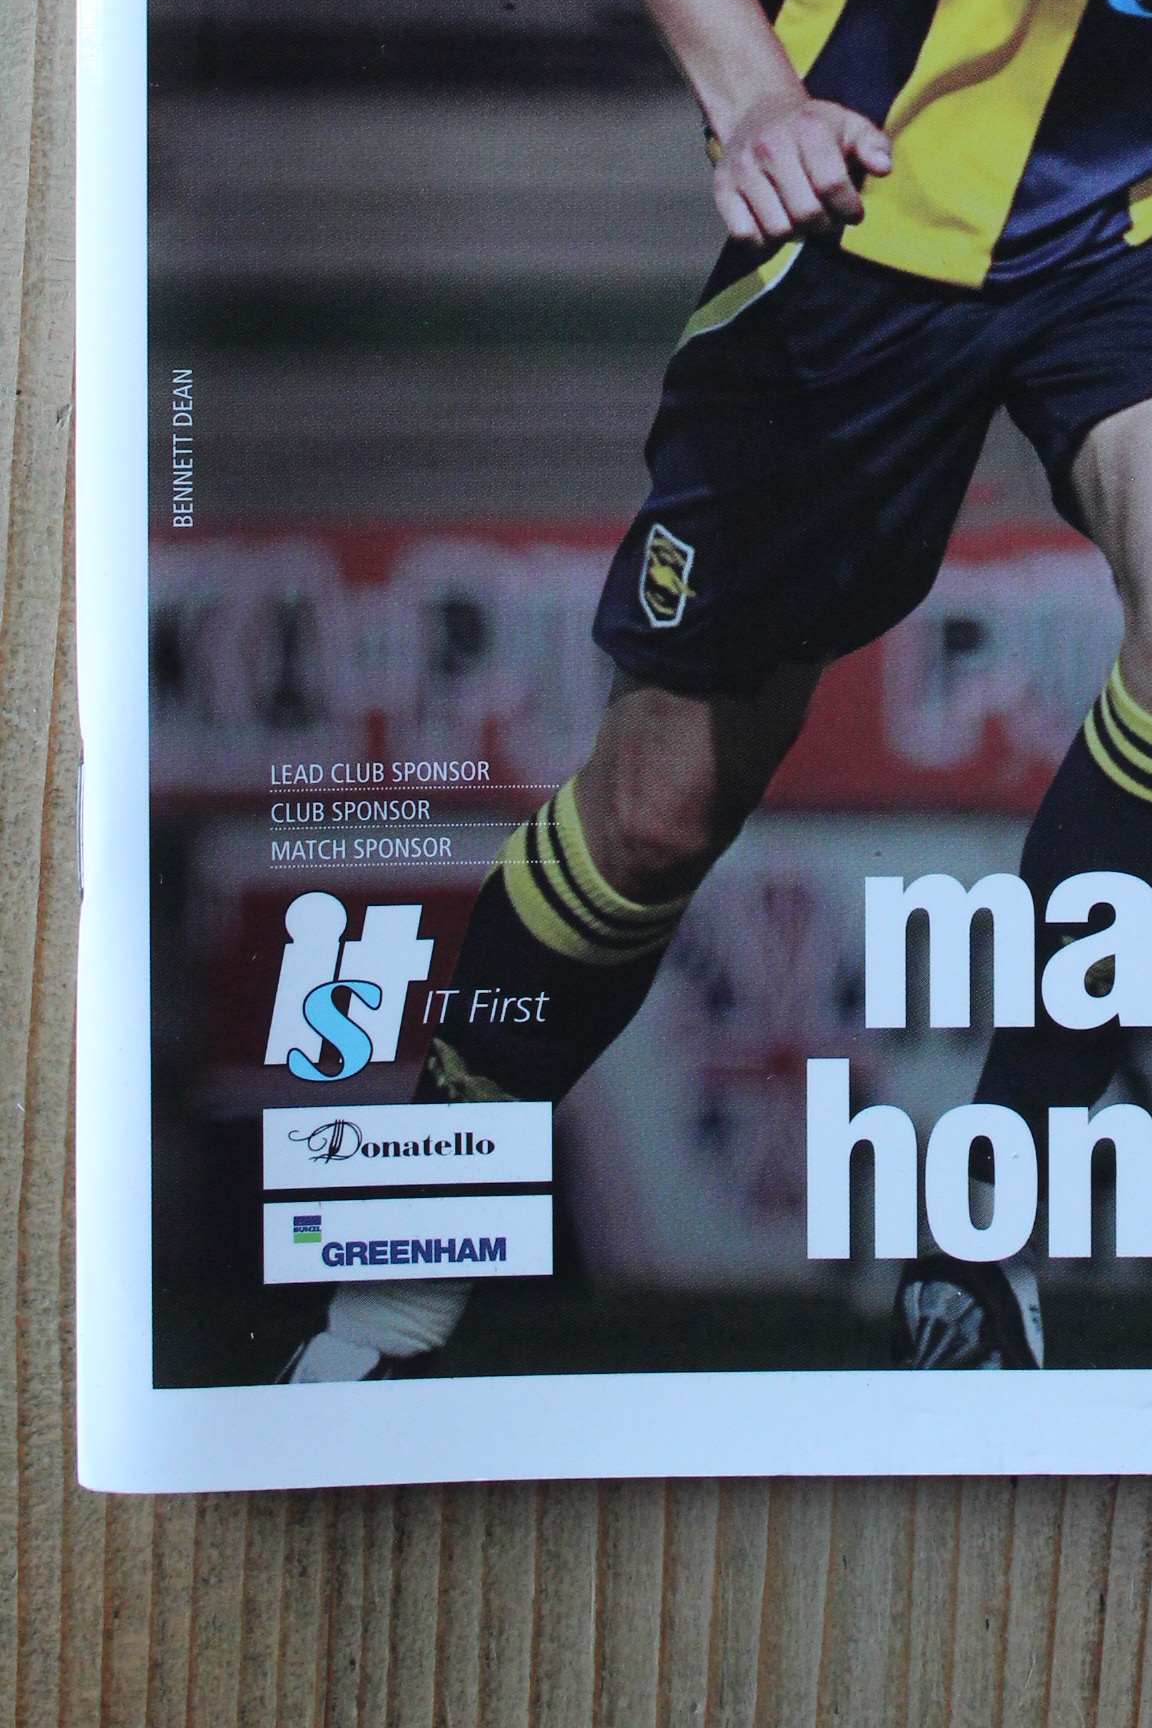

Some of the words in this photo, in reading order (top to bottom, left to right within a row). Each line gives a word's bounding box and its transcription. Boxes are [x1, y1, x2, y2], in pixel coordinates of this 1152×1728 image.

[172, 369, 194, 427] DEAN
[172, 434, 194, 528] BENNETT
[271, 764, 324, 785] LEAD
[331, 762, 385, 783] CLUB
[392, 760, 490, 781] SPONSOR
[271, 802, 325, 823] CLUB
[332, 800, 430, 822] SPONSOR
[271, 838, 346, 861] MATCH
[353, 837, 452, 859] SPONSOR
[423, 990, 460, 1024] IT
[469, 988, 550, 1024] First
[288, 1119, 495, 1164] Donatello
[321, 1237, 507, 1267] GREENHAM
